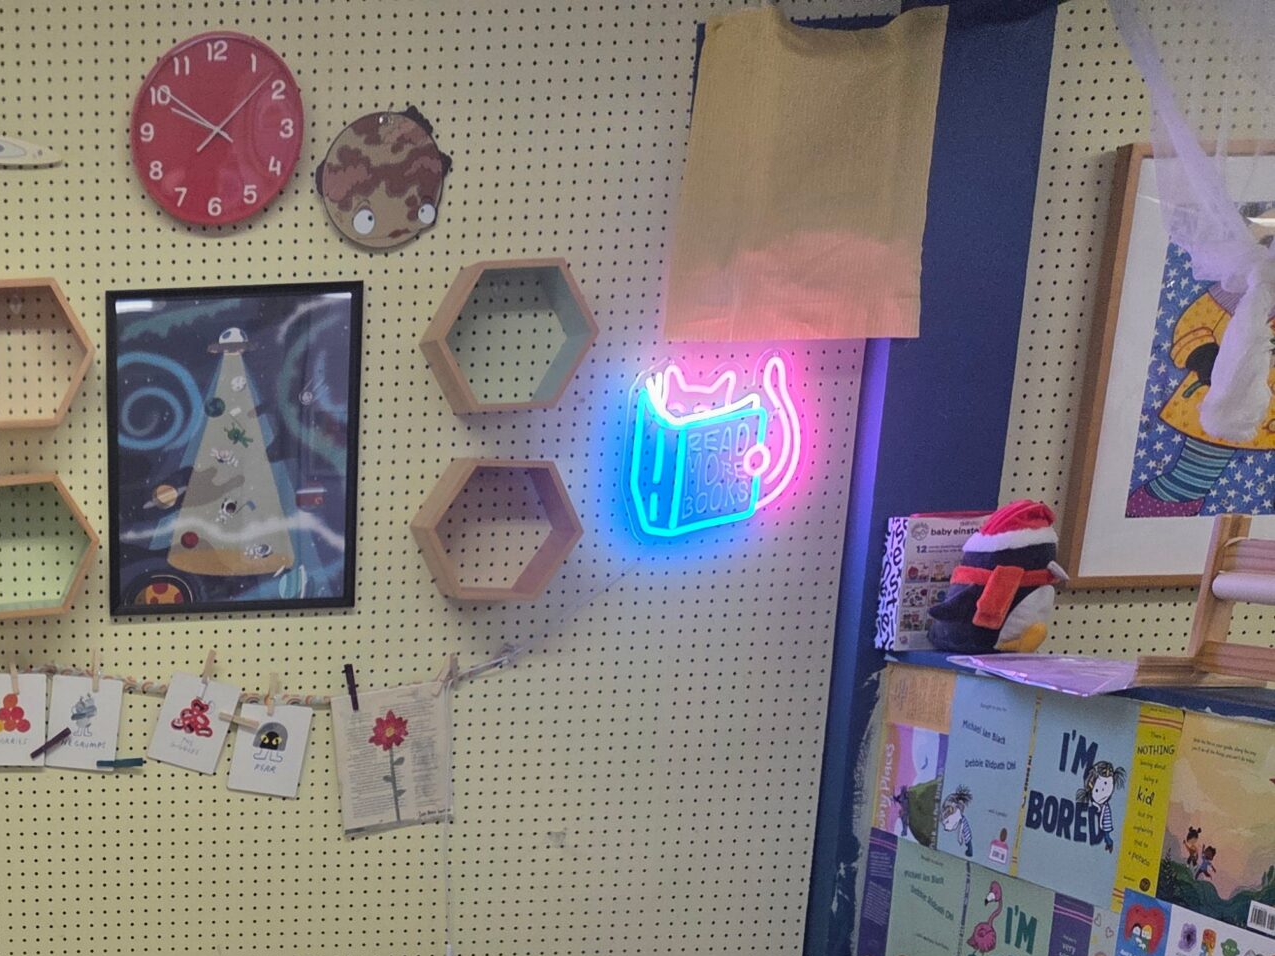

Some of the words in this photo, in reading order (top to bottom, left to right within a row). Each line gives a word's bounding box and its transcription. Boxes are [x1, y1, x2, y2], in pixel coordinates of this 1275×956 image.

[206, 40, 228, 62] 12
[174, 55, 190, 76] 11
[251, 53, 257, 73] 1
[150, 84, 171, 106] 10
[271, 79, 286, 100] 2
[140, 122, 155, 142] 9
[279, 118, 294, 138] 3
[149, 160, 163, 180] 8
[268, 156, 281, 176] 4
[175, 187, 187, 207] 7
[243, 184, 258, 204] 5
[207, 197, 222, 216] 6
[687, 422, 751, 460] READ
[685, 452, 748, 496] MORE
[682, 480, 749, 519] BOOKS
[931, 527, 953, 537] baby
[1059, 728, 1099, 780] I'M
[1137, 744, 1175, 756] NOTHING
[1136, 785, 1155, 806] kid
[1025, 789, 1105, 846] BORED
[1004, 905, 1038, 955] I'M
